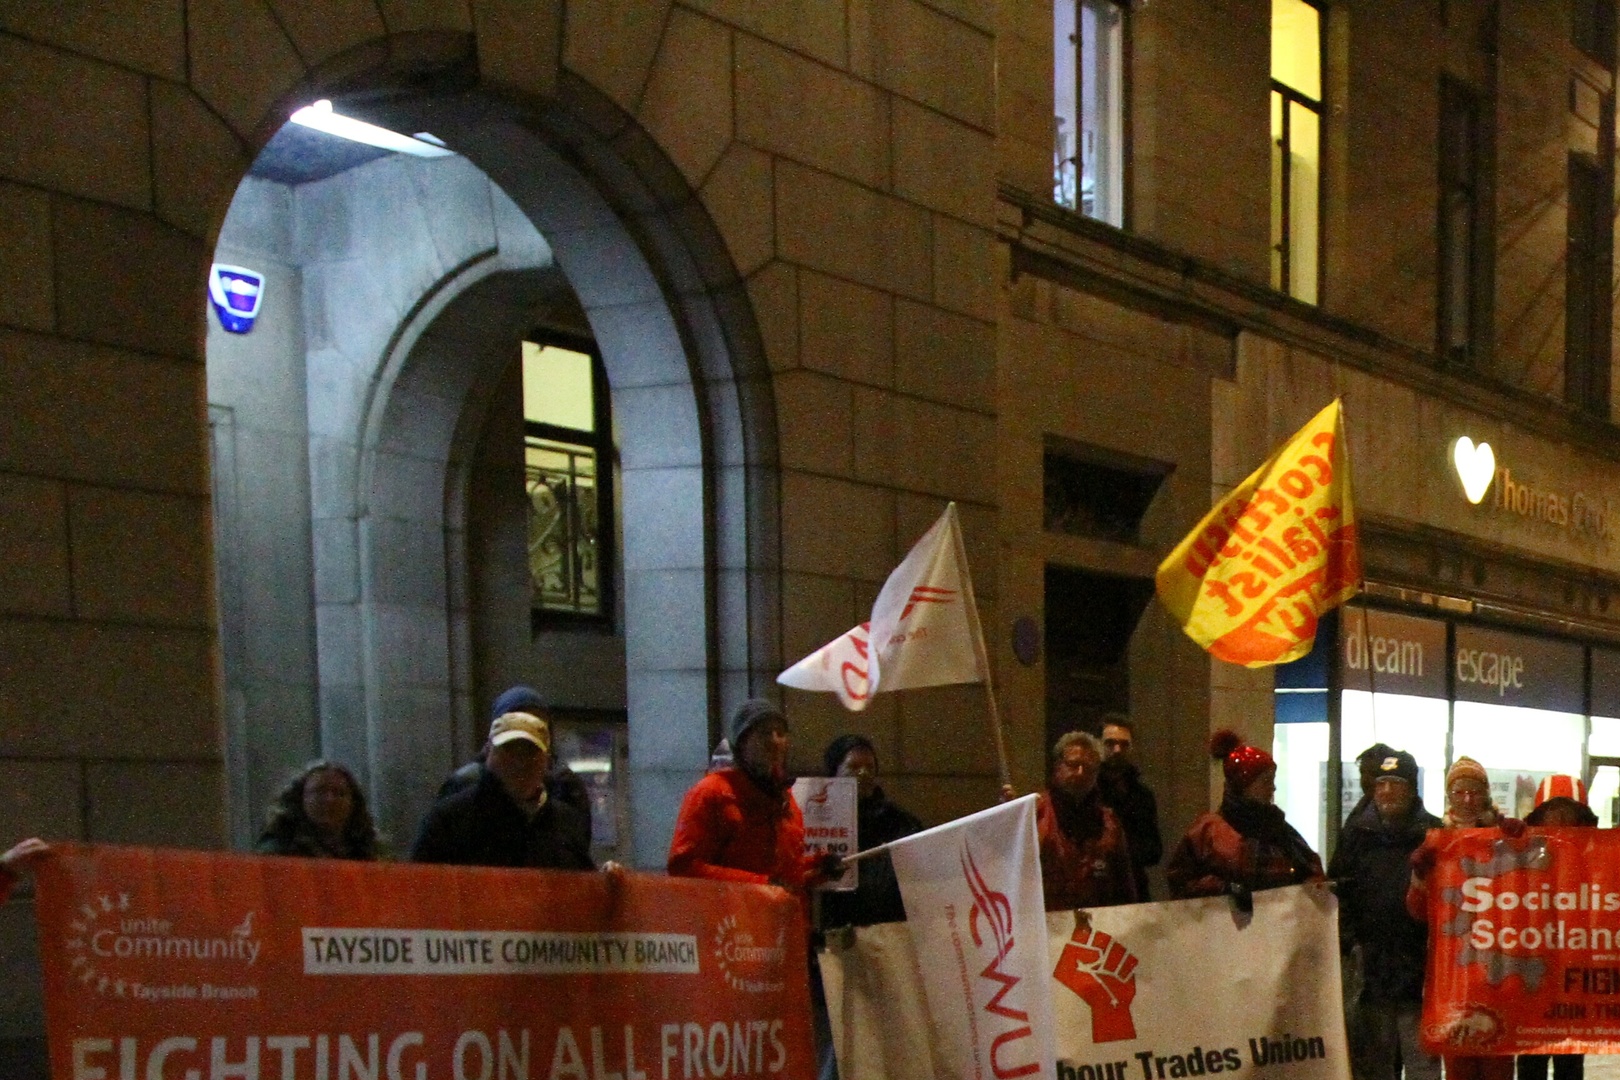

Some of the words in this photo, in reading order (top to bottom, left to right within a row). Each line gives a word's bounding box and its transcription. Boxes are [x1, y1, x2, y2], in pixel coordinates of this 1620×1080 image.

[1494, 466, 1568, 527] Thomas
[1346, 619, 1424, 677] dream
[1456, 649, 1524, 697] escape
[92, 928, 261, 966] Community
[312, 936, 413, 965] TAYSIDE
[426, 937, 495, 965] UNITE
[502, 938, 628, 966] COMMUNITY
[635, 938, 696, 966] BRANCH
[201, 984, 259, 998] Branch
[969, 890, 1042, 1080] CWU
[1544, 1003, 1587, 1020] JOIN
[661, 1020, 787, 1079] FRONTS
[1250, 1033, 1326, 1068] Union
